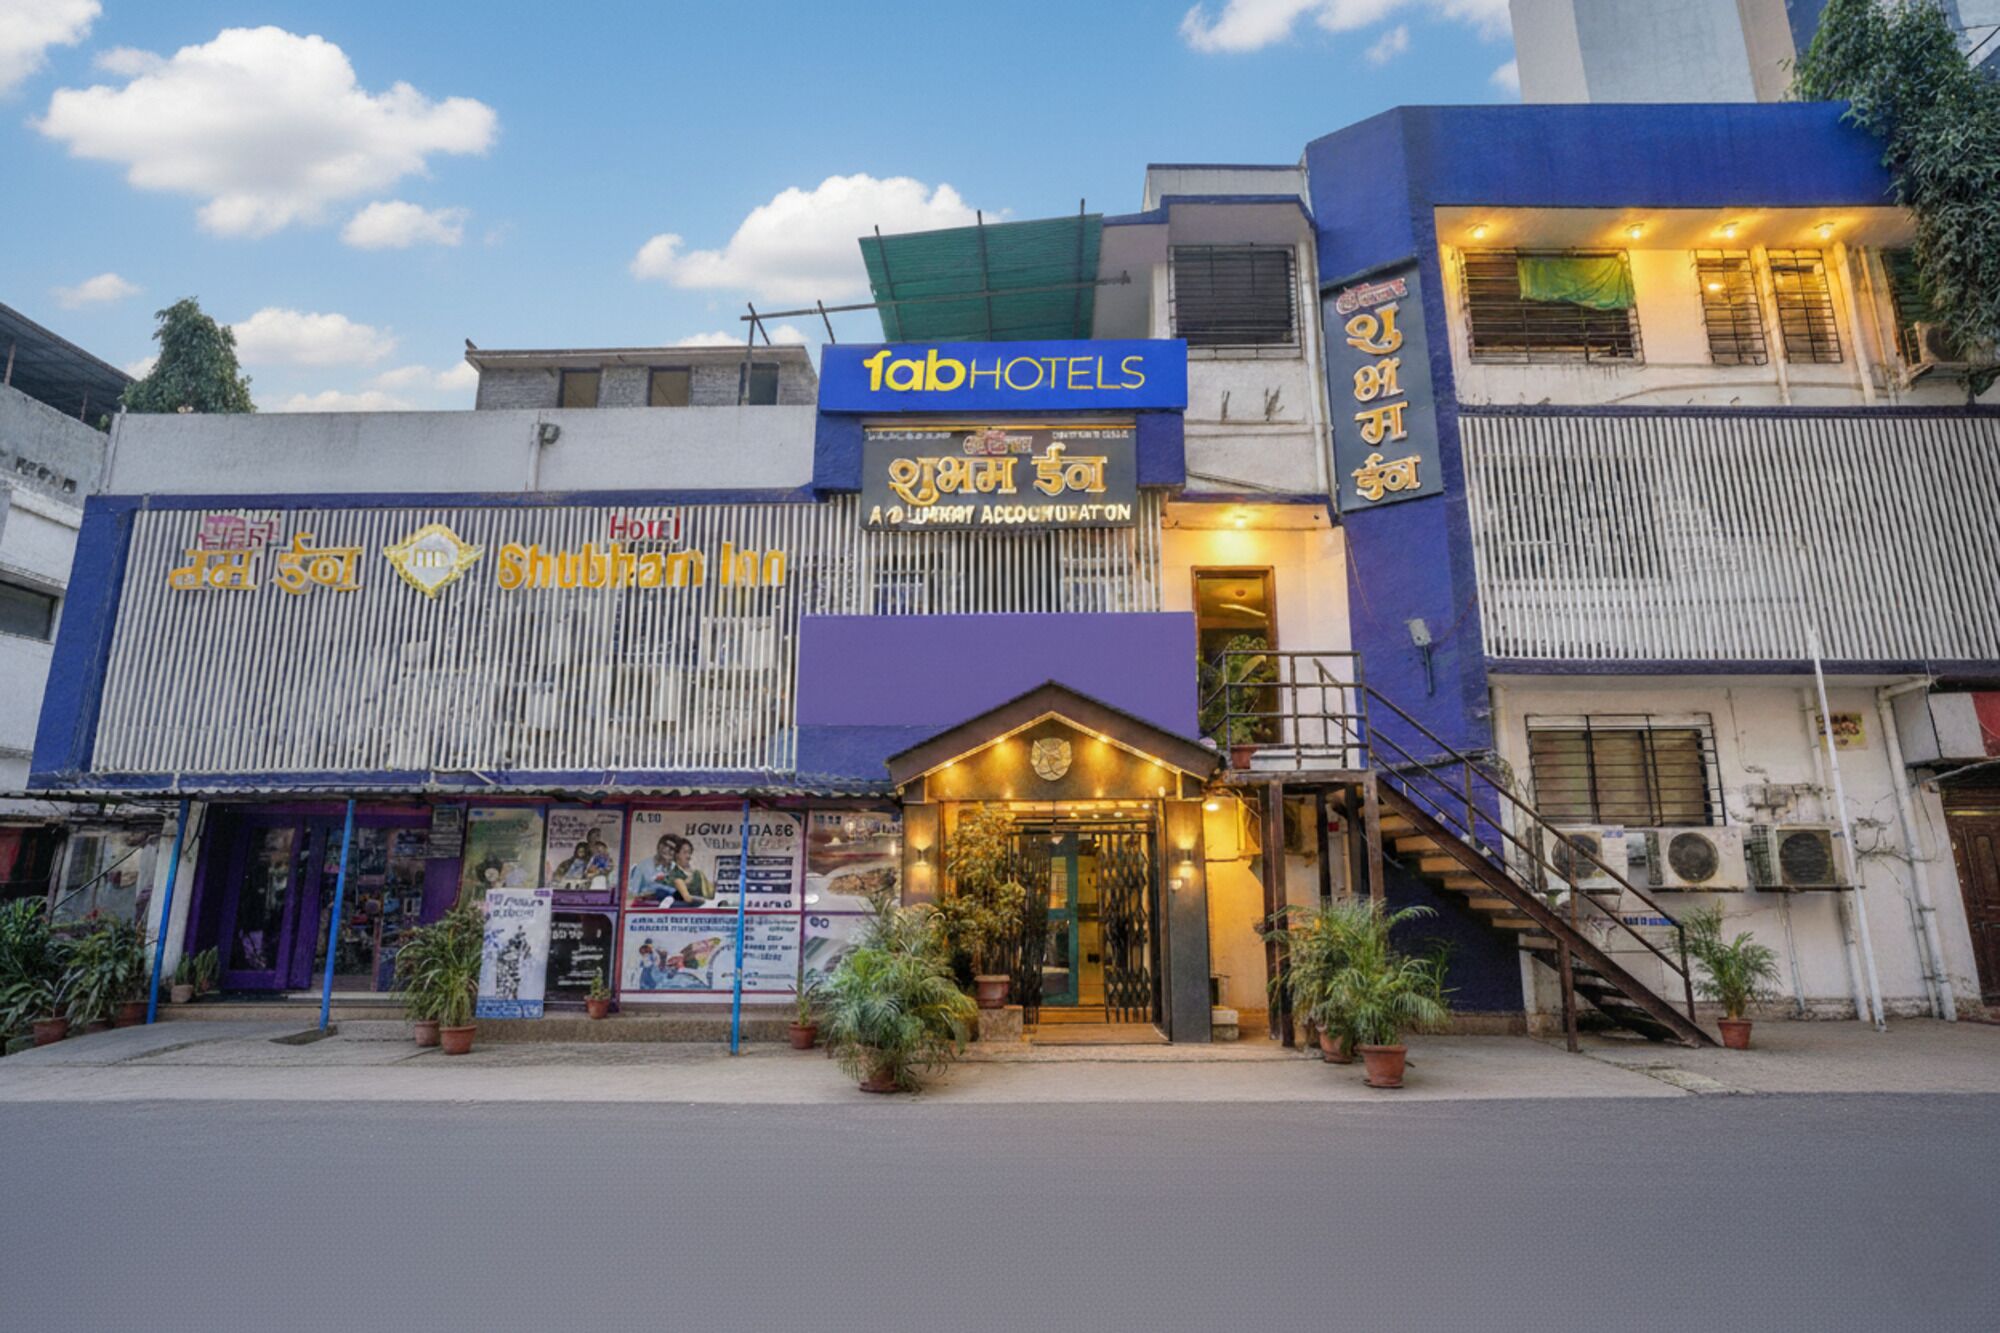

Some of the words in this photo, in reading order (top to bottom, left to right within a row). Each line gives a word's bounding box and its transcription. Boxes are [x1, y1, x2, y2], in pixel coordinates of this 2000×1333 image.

[888, 456, 1018, 506] शुभम
[1031, 442, 1108, 496] ईन
[499, 542, 705, 590] Shubham
[721, 541, 786, 588] Inn
